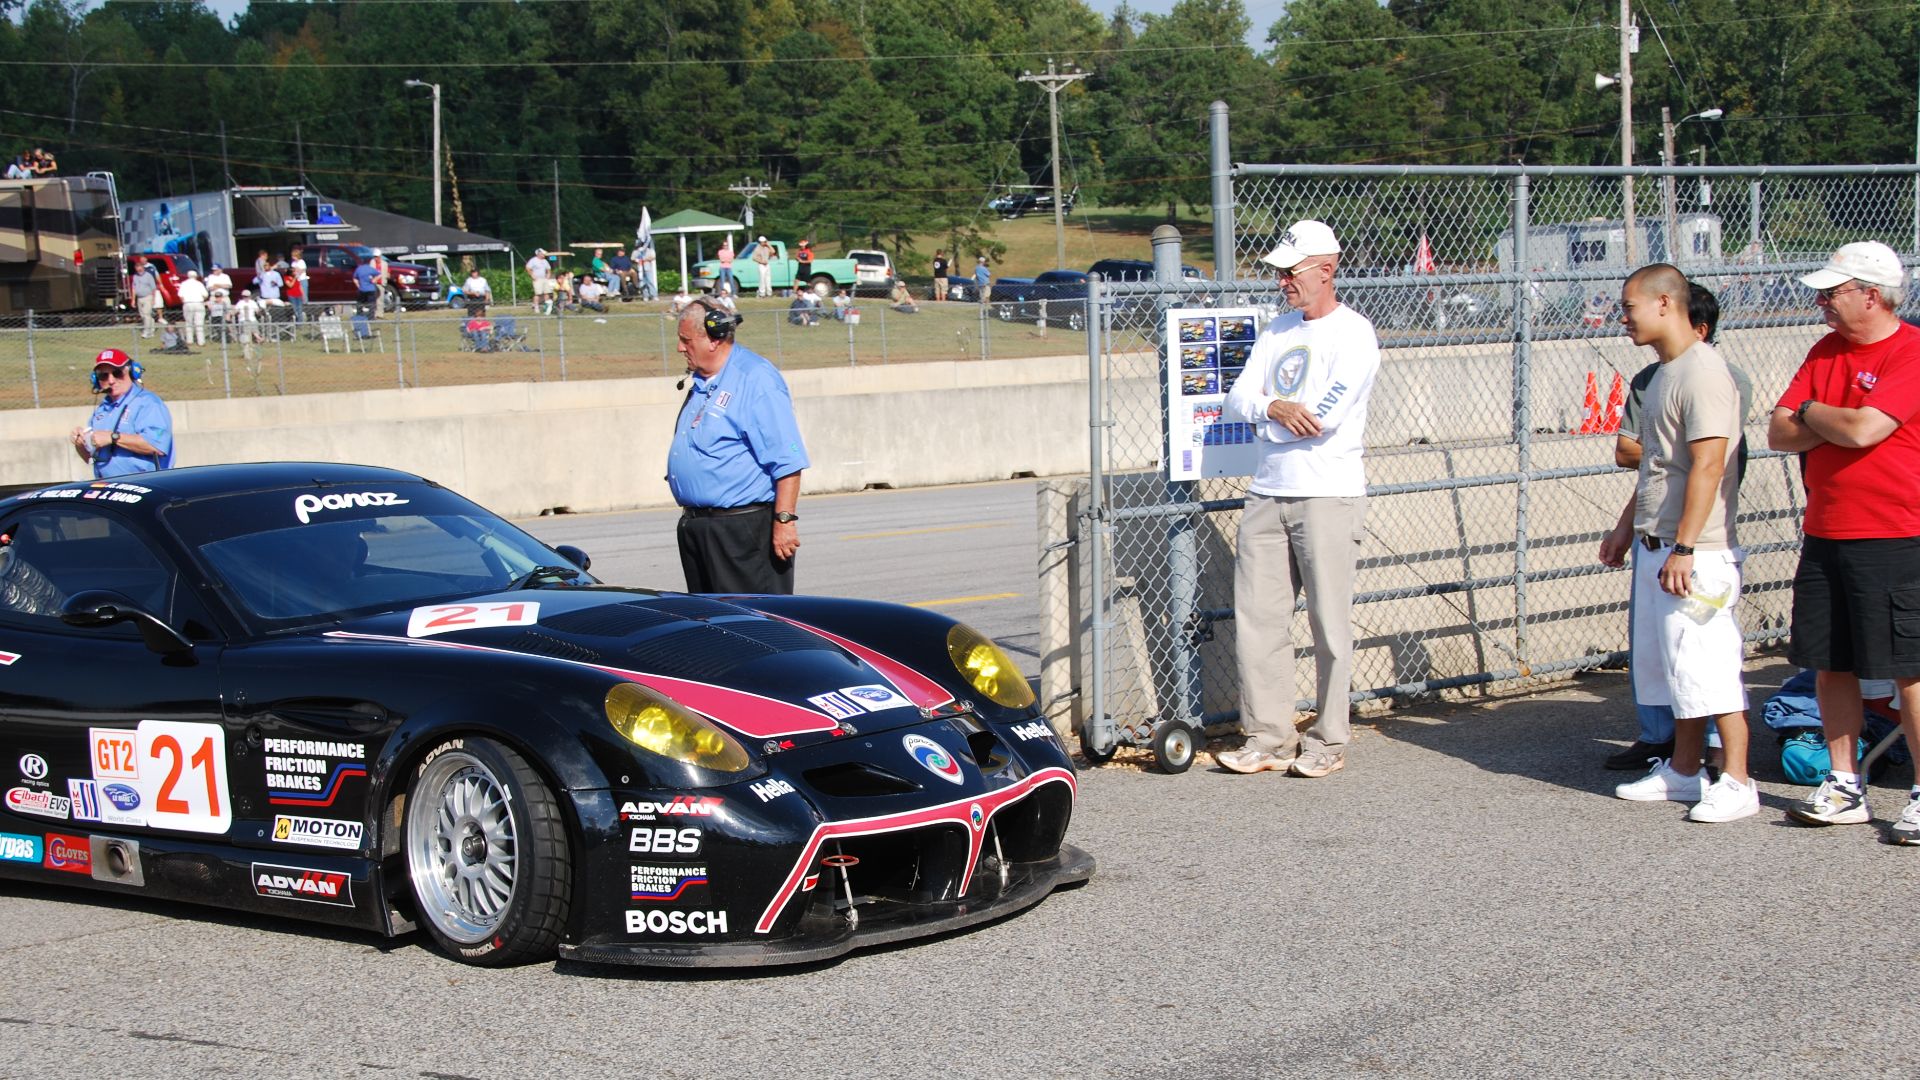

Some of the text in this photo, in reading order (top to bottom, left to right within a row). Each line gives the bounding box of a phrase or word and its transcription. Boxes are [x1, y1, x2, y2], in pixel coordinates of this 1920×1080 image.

[424, 603, 525, 628] 21
[1011, 722, 1054, 742] Hella
[97, 738, 135, 772] GT2
[264, 738, 365, 759] PERFORMANCE
[418, 739, 464, 779] ADVAN
[150, 734, 221, 817] 21
[265, 756, 327, 774] FRICTION
[266, 773, 322, 791] BRAKES
[749, 778, 797, 803] Hella
[9, 789, 49, 804] Eibach
[50, 797, 69, 812] EVS
[72, 781, 83, 817] IMSA
[620, 801, 710, 815] ADVAN
[292, 819, 362, 839] MOTON
[0, 836, 34, 859] rgas
[629, 827, 702, 854] BBS
[630, 865, 707, 877] PERFORMANCE
[631, 875, 677, 885] FRICTION
[257, 873, 337, 895] ADVAN
[631, 883, 672, 893] BRAKES
[625, 909, 728, 935] BOSCH
